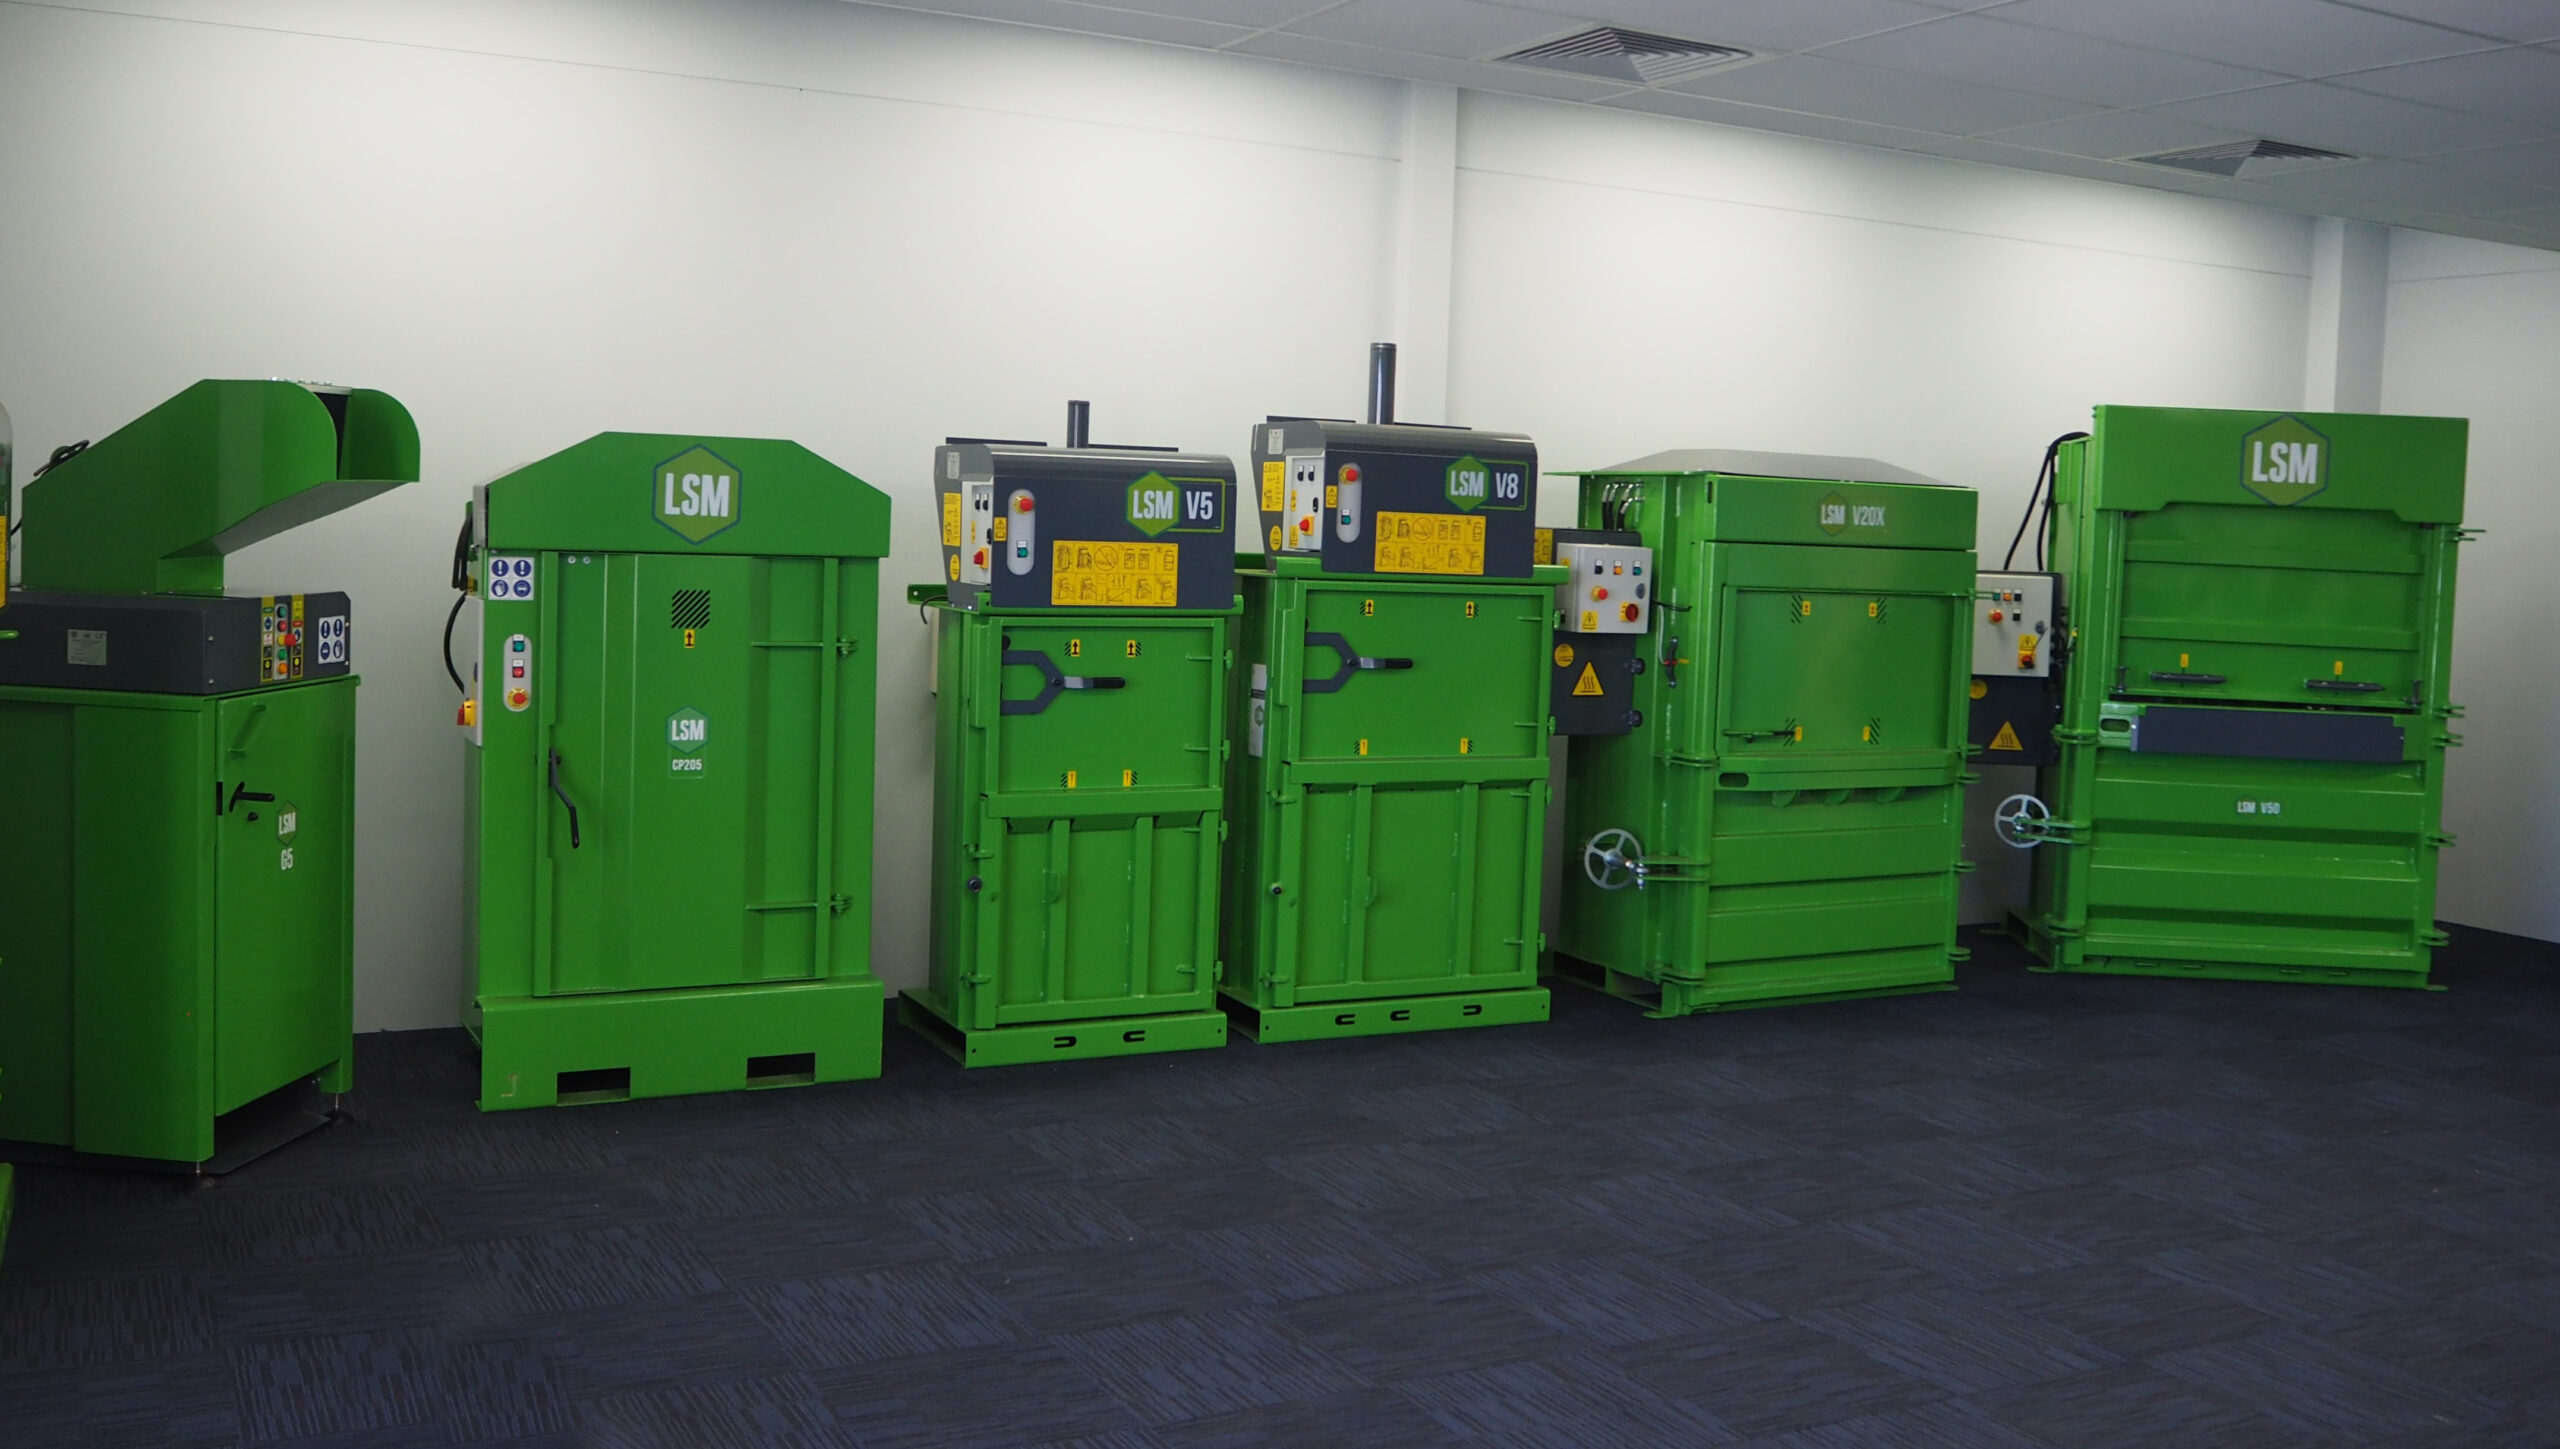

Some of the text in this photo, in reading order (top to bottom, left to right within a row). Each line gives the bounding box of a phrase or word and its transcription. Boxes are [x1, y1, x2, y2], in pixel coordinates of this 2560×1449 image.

[2250, 440, 2320, 485] LSM
[664, 472, 731, 517] LSM
[1450, 471, 1519, 500] LSM V8
[1132, 489, 1213, 520] LSM V5
[1820, 504, 1886, 527] LSM V20X
[671, 718, 705, 742] LSM
[672, 758, 703, 772] CP205
[2237, 801, 2281, 815] LSM V50
[278, 812, 297, 836] LSM
[280, 848, 294, 871] G5
